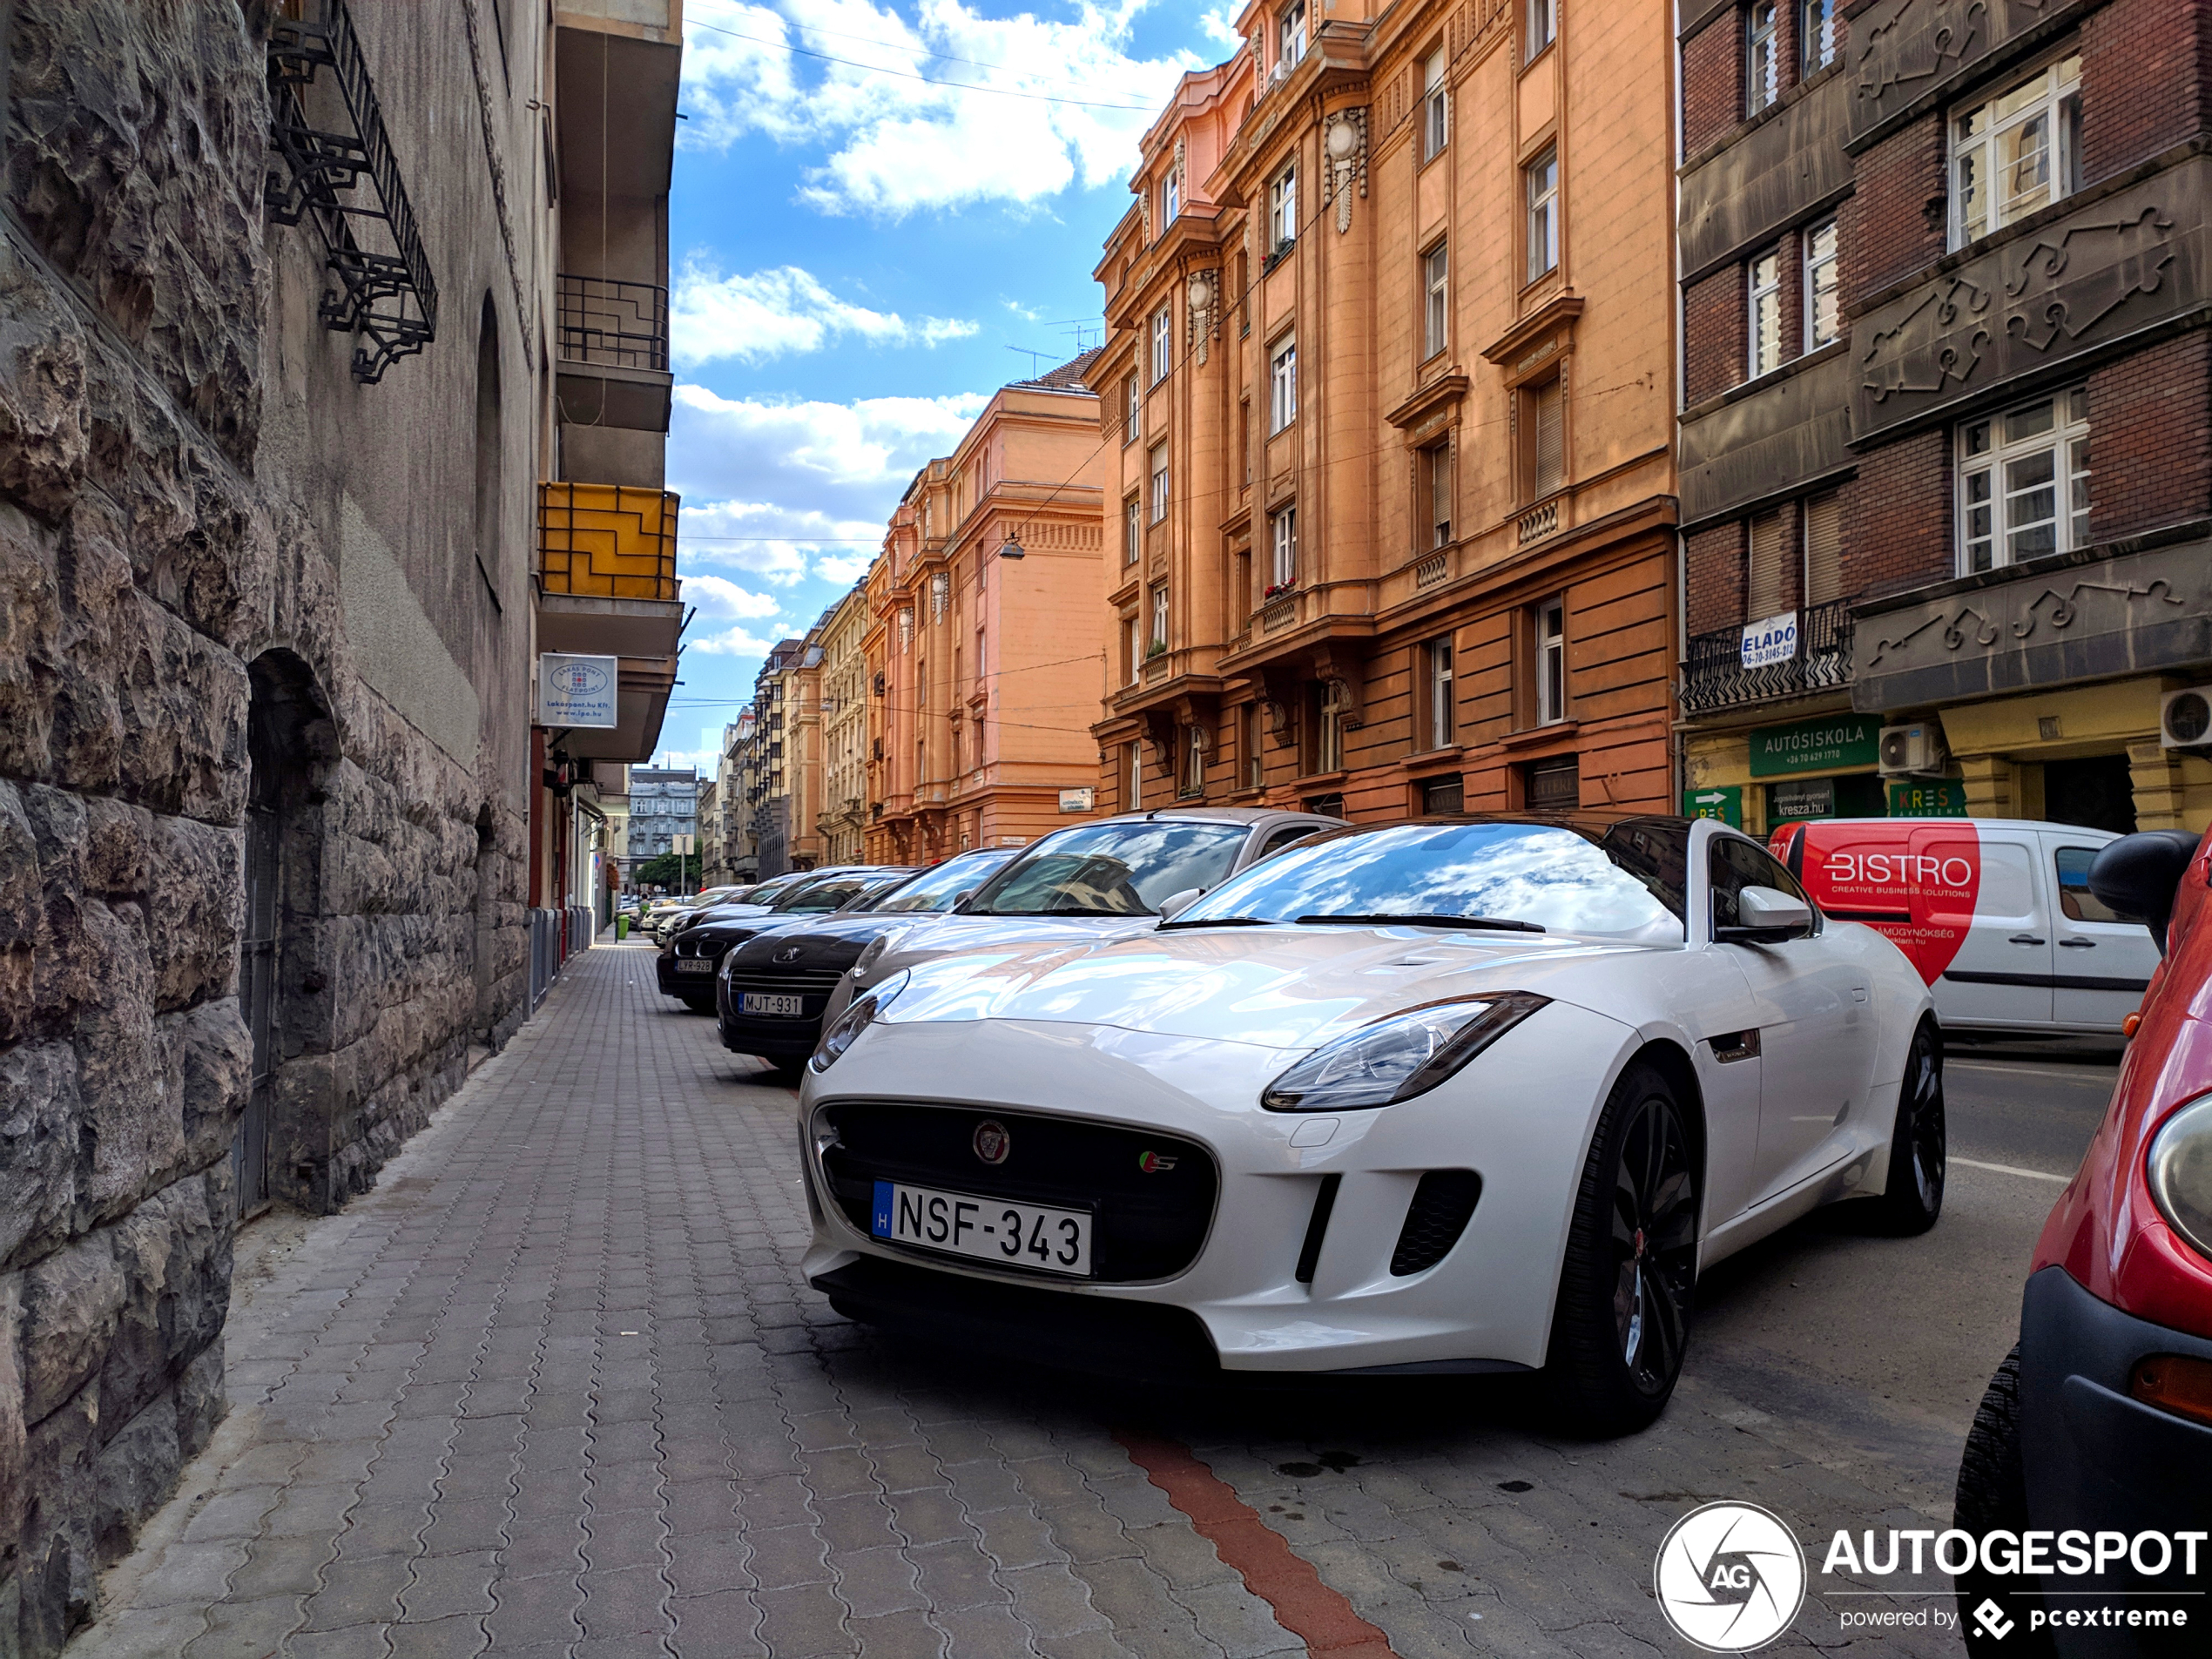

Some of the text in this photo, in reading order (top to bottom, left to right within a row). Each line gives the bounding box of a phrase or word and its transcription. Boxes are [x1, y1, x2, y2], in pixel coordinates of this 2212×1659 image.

[1743, 621, 1796, 652] ELADÓ
[582, 666, 601, 678] PONT
[562, 685, 600, 693] FLAT POINT
[1764, 725, 1865, 753] AUTÓSISKOLA
[1786, 750, 1840, 765] +36 70 629 1770
[1779, 802, 1824, 816] kresza.hu
[1823, 853, 1972, 887] BISTRO
[1876, 887, 1920, 895] BUSINESS
[1922, 888, 1971, 899] SOLUTIONS
[746, 995, 798, 1013] MJT-931
[878, 1190, 1081, 1266] H NSF-343
